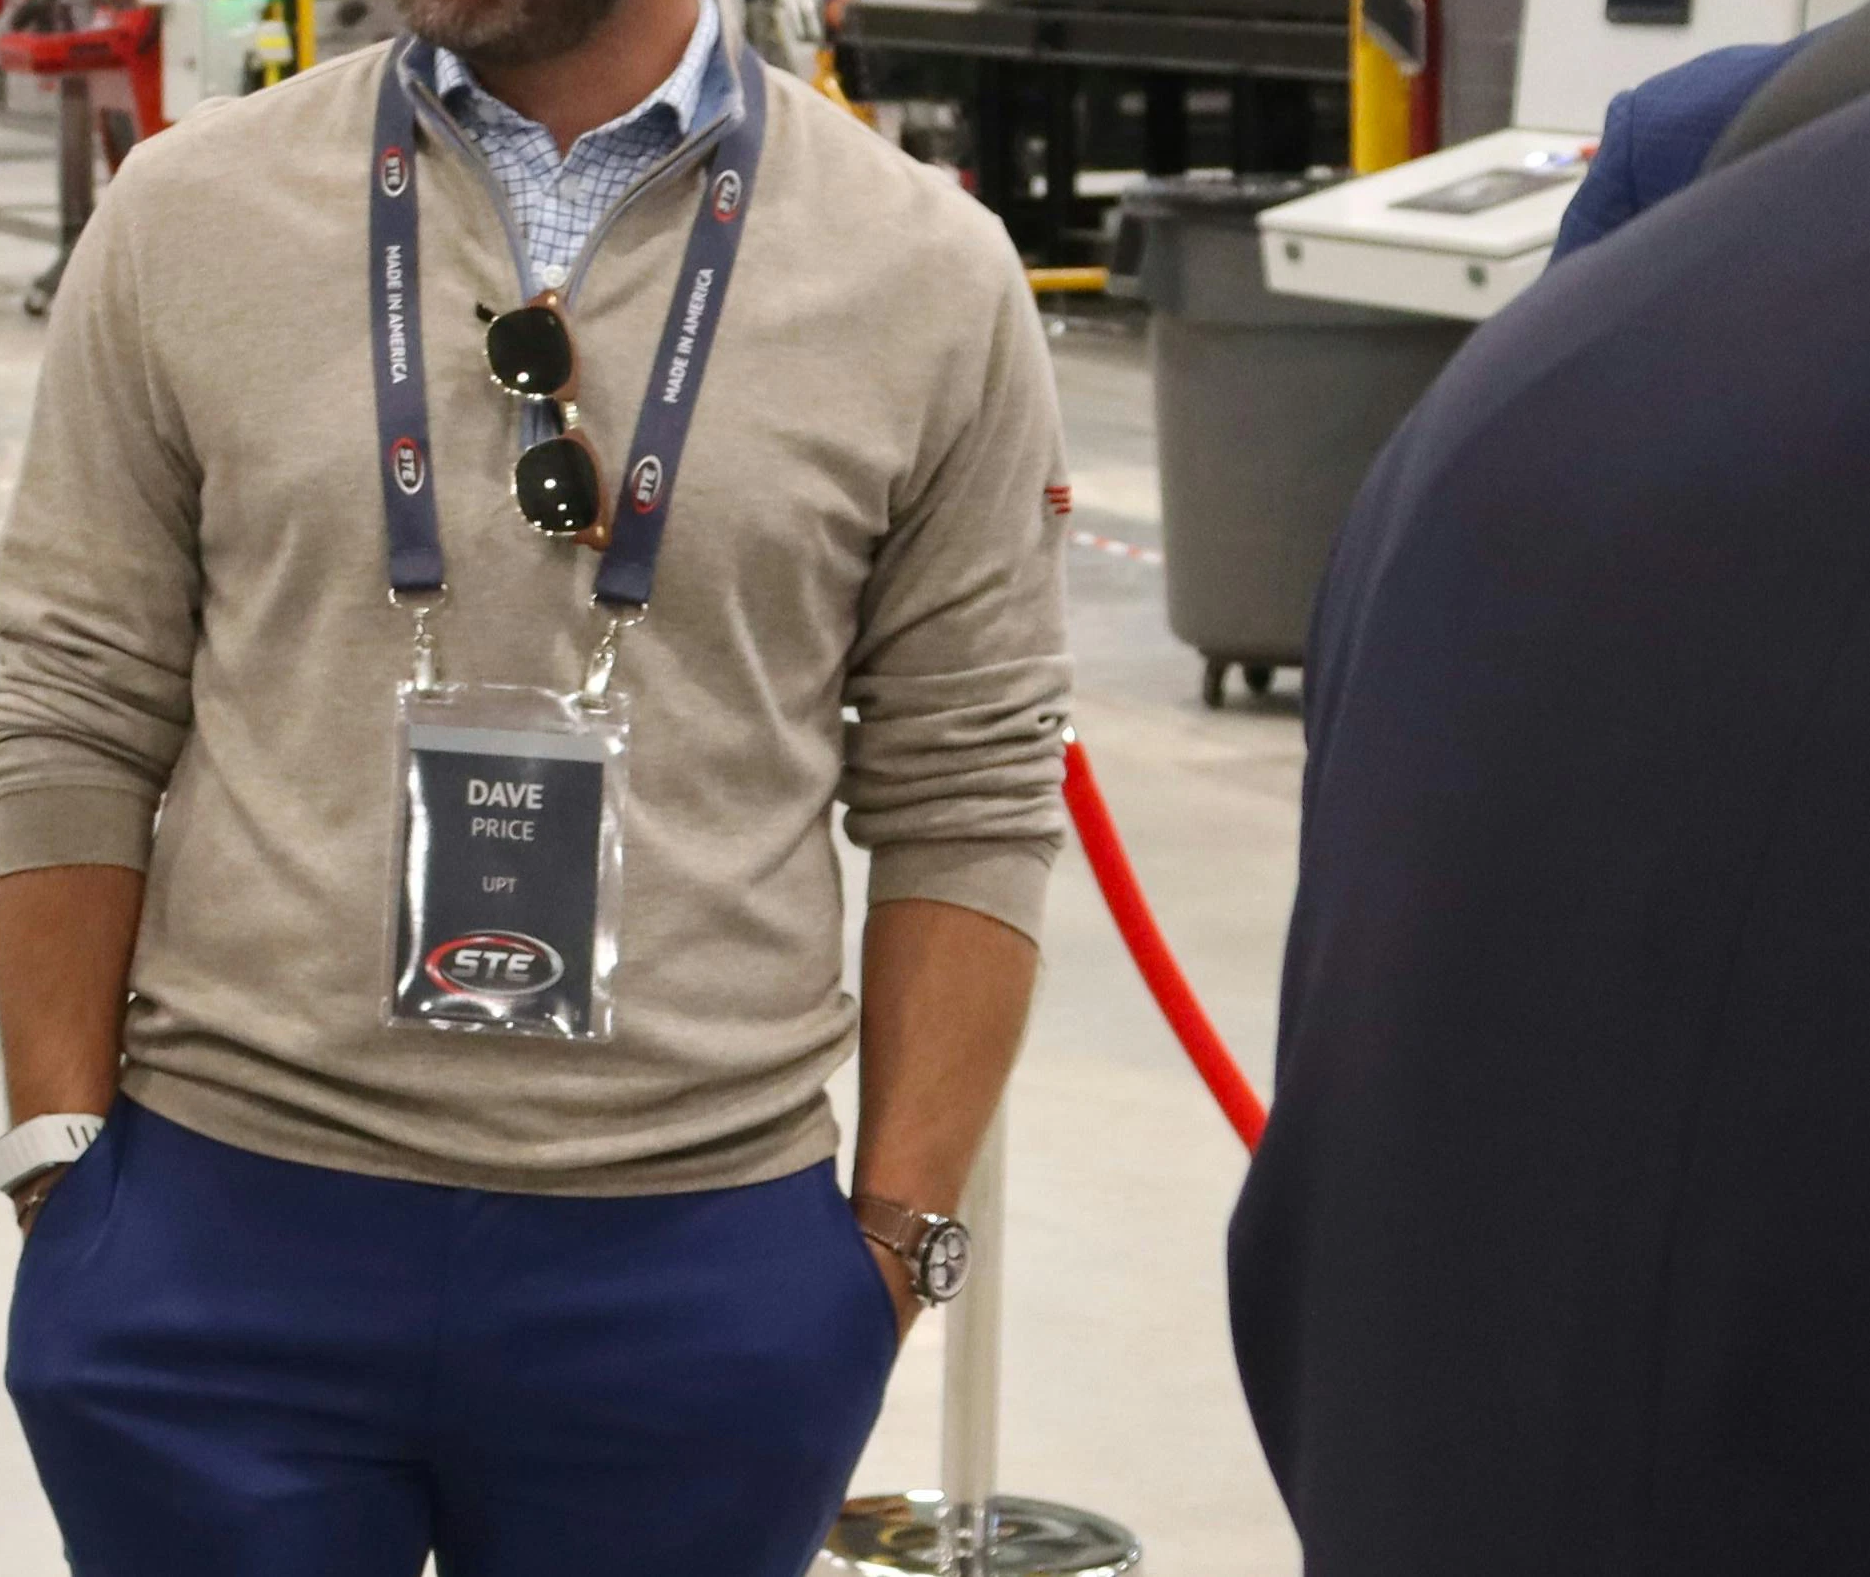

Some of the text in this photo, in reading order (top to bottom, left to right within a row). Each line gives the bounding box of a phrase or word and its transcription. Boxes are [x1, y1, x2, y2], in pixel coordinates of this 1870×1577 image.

[385, 156, 401, 186] STE
[385, 244, 408, 384] MADE IN AMERICA
[662, 268, 714, 404] MADE IN AMERICA
[399, 447, 417, 482] STE
[467, 778, 545, 811] DAVE
[471, 817, 536, 843] PRICE
[481, 875, 517, 894] UPT
[450, 949, 536, 983] STE
